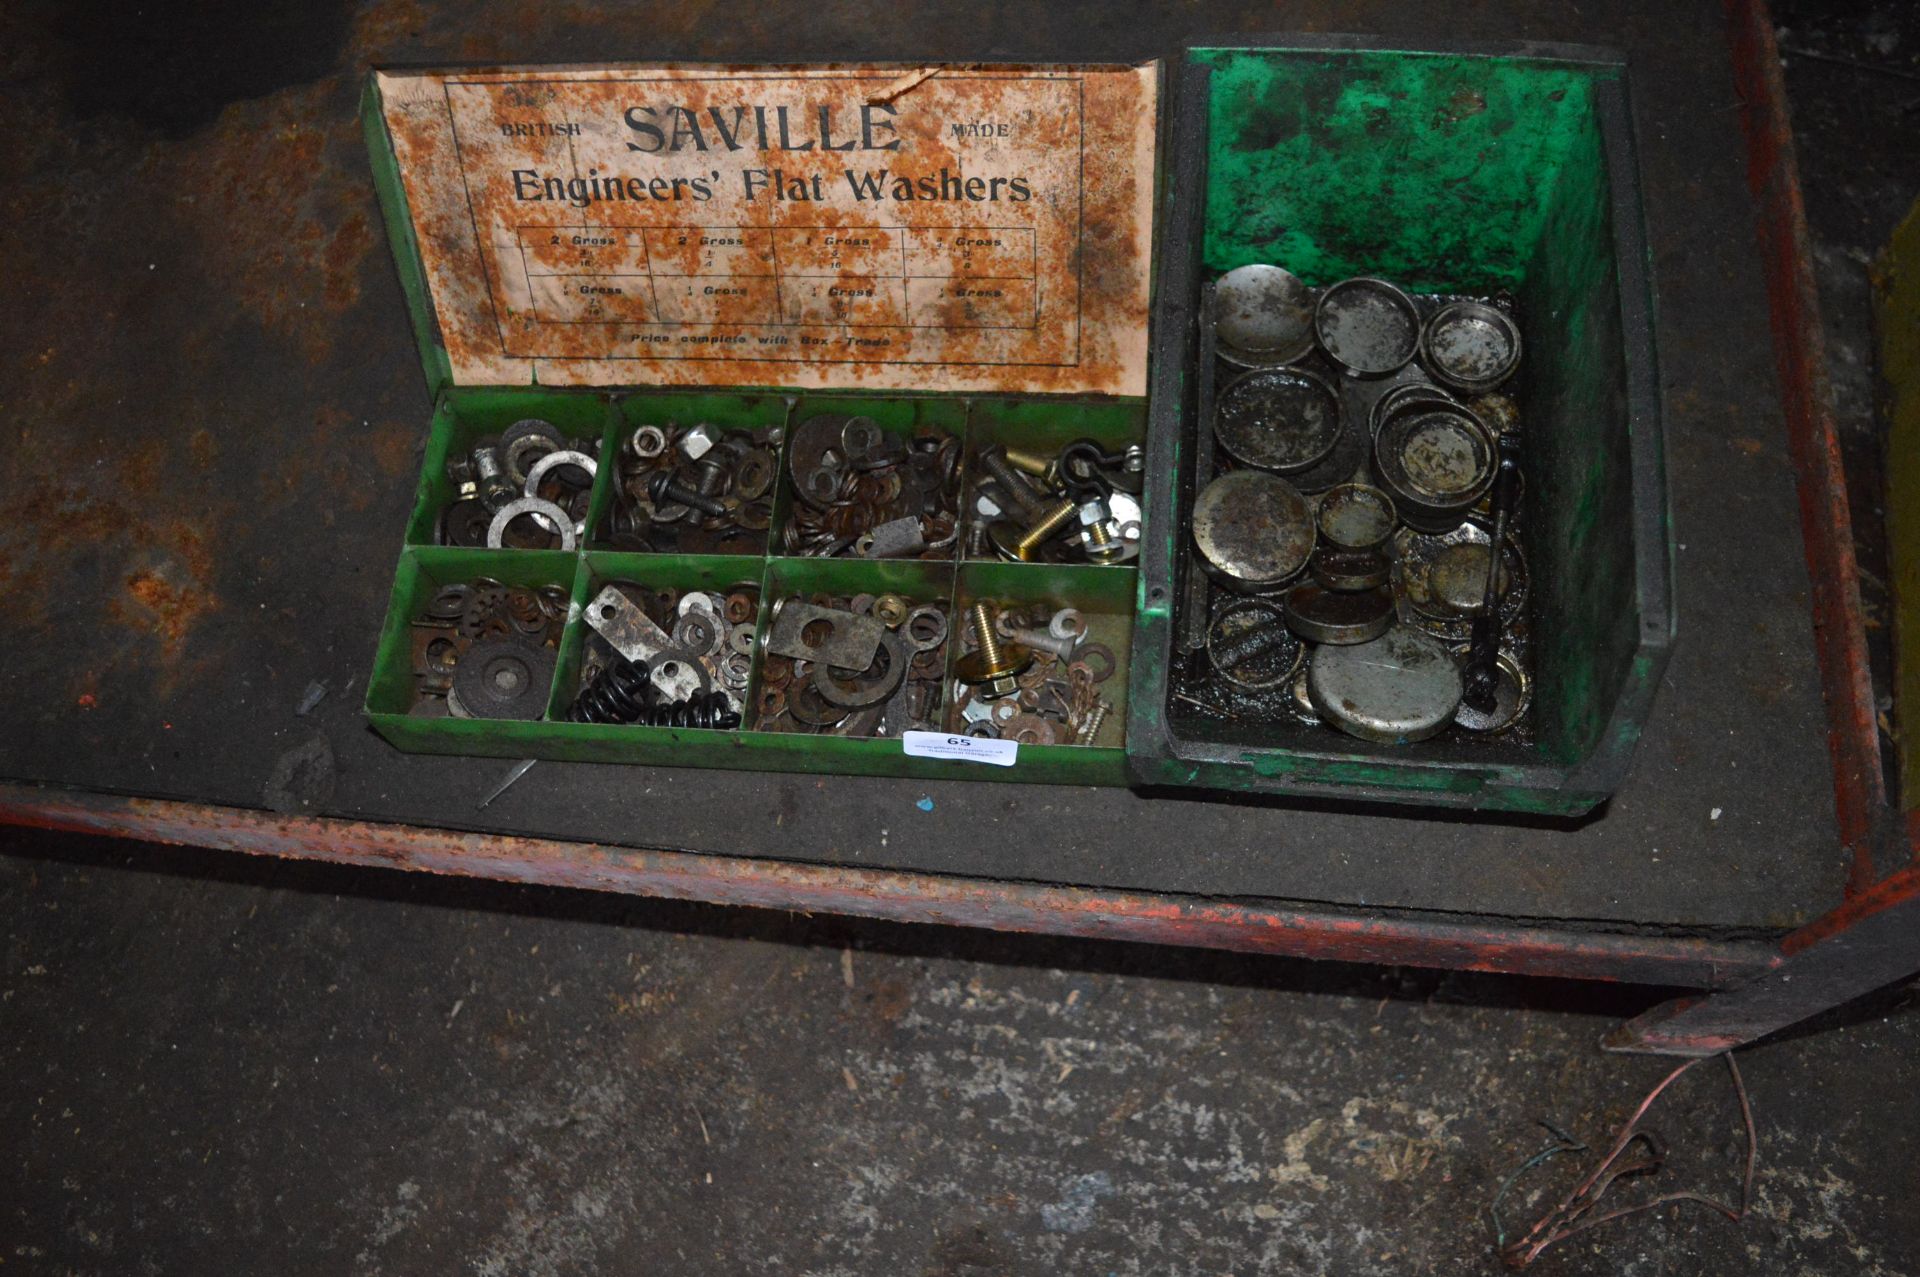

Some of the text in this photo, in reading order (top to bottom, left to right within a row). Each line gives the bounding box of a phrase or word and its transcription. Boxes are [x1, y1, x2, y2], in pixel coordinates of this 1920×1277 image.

[501, 122, 582, 138] BRITISH
[624, 104, 901, 153] SAVILLE
[950, 122, 1009, 138] MADE
[742, 168, 825, 201] Flat
[844, 168, 1032, 202] Washers
[551, 235, 617, 246] 2 Gross
[678, 236, 745, 246] 2 Gross
[824, 236, 871, 246] Gross
[954, 236, 1002, 247] Gross
[580, 285, 623, 296] Gross
[704, 286, 749, 297] Gross
[828, 287, 875, 298] Gross
[956, 288, 1004, 298] Gross
[631, 333, 891, 347] Price complete with Box Trade
[947, 737, 971, 746] 65
